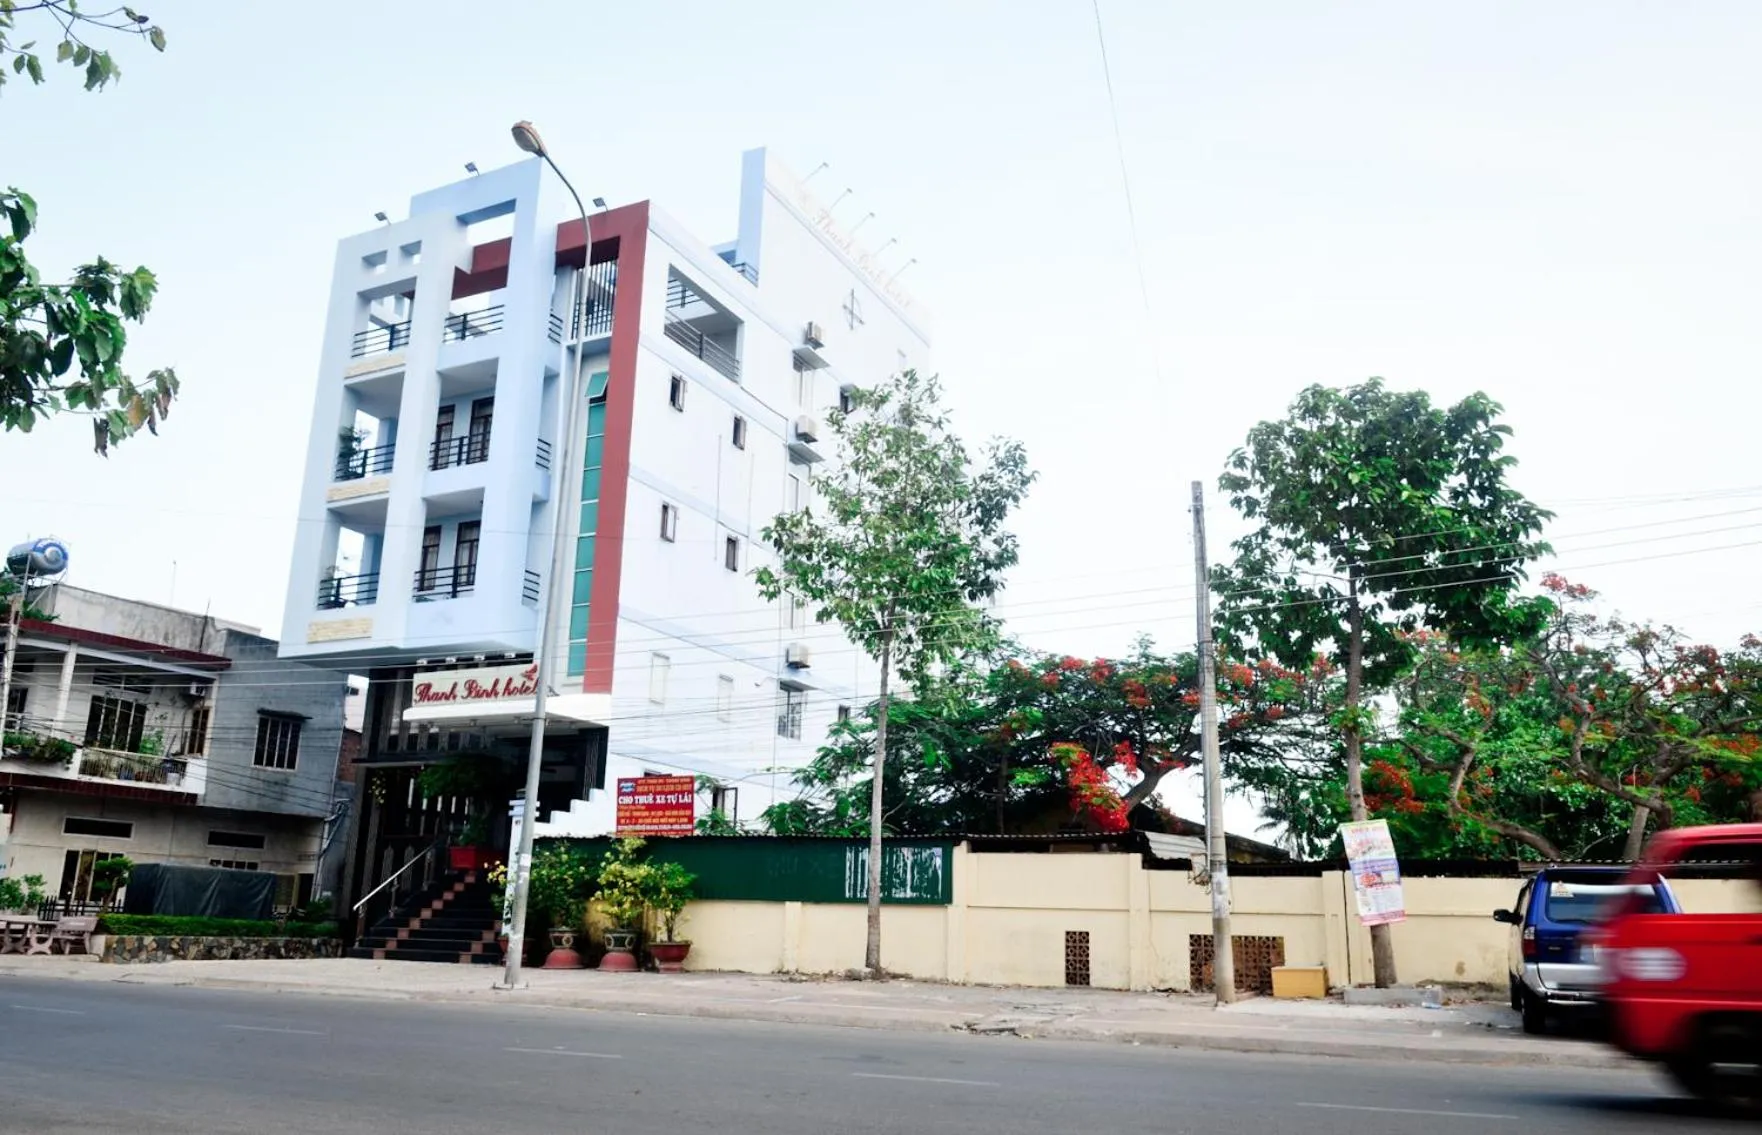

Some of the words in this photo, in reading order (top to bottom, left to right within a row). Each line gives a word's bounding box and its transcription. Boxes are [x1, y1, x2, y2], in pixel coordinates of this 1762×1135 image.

[414, 682, 458, 703] Thanh
[619, 795, 633, 804] CHO
[635, 793, 654, 804] THUÊ
[655, 794, 666, 804] XE
[679, 792, 692, 803] LÁI
